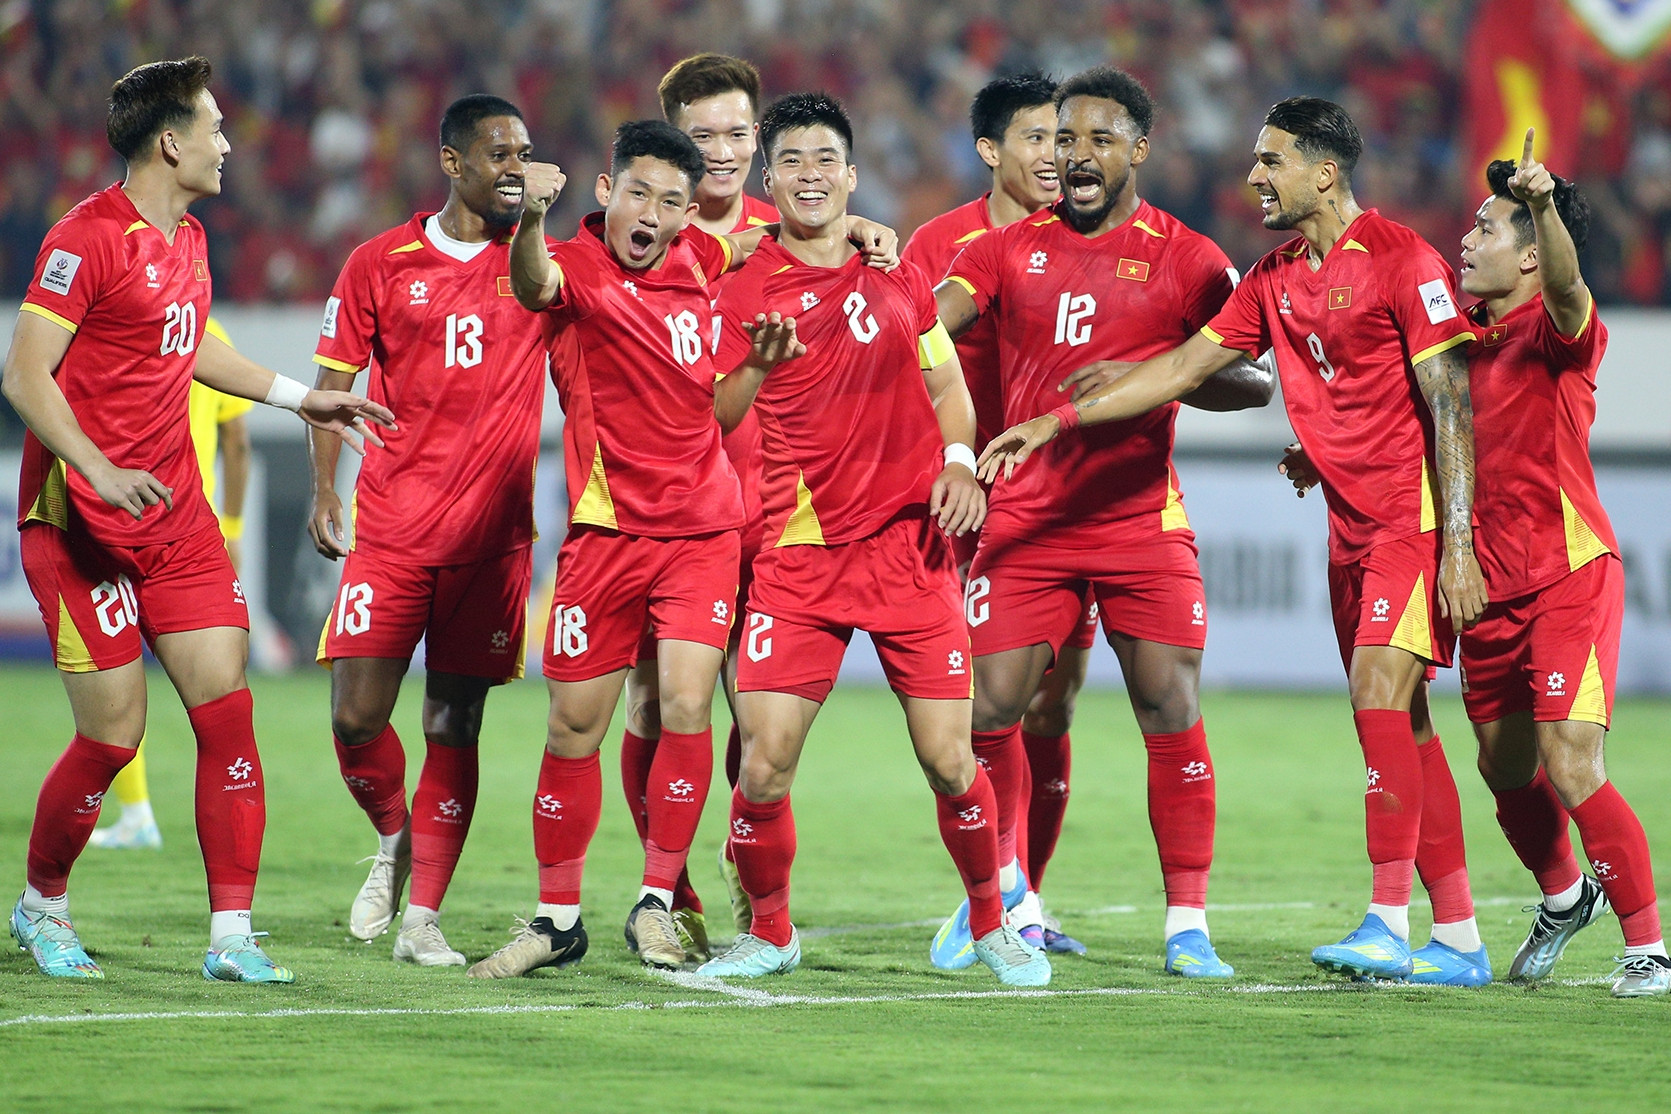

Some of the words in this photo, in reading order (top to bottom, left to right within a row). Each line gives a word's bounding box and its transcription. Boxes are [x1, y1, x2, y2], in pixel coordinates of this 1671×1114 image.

[160, 301, 197, 357] 20
[842, 291, 880, 345] 2
[1054, 291, 1097, 347] 12
[1429, 294, 1447, 308] AFC
[444, 313, 484, 369] 13
[664, 309, 702, 365] 18
[1306, 332, 1336, 384] 9
[90, 572, 138, 638] 20
[335, 581, 375, 637] 13
[552, 604, 589, 658] 18
[746, 612, 774, 663] 2
